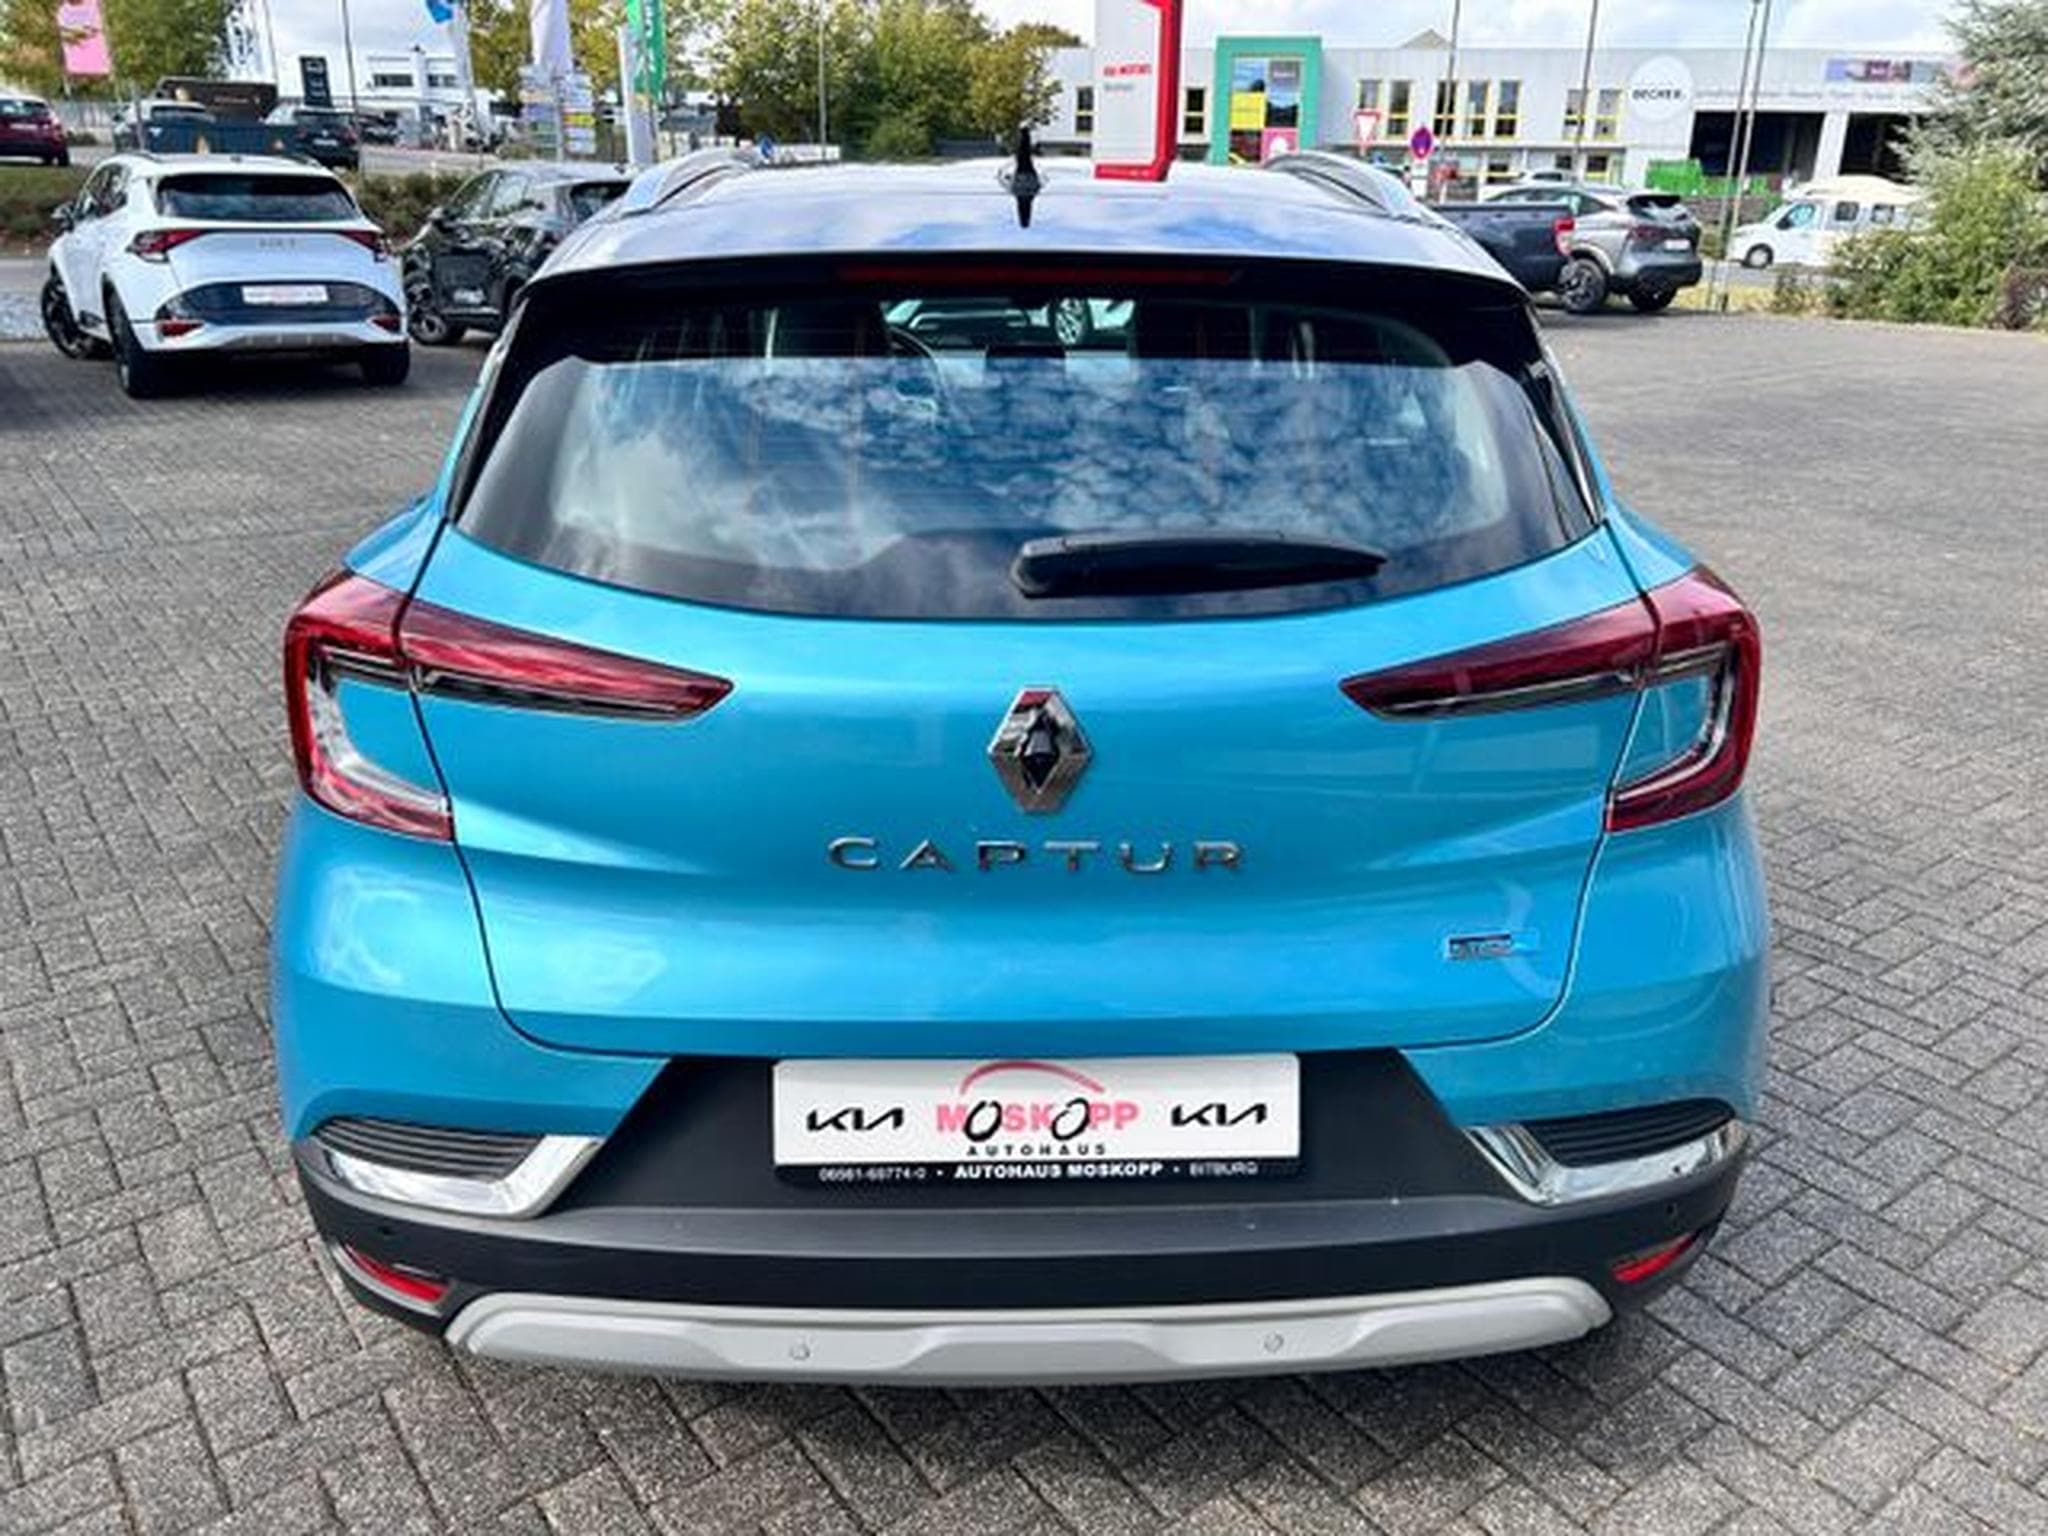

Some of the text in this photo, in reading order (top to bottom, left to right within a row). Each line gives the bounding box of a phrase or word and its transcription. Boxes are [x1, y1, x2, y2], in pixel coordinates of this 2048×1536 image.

[827, 836, 1244, 874] CAPTUR
[806, 1107, 904, 1132] KIA
[936, 1098, 1139, 1142] MOSKOPP
[1171, 1103, 1268, 1128] KIA
[966, 1144, 1106, 1156] AUTOHAUS
[953, 1164, 1061, 1179] AUTOHAUS
[1066, 1161, 1164, 1179] MOSKOPP
